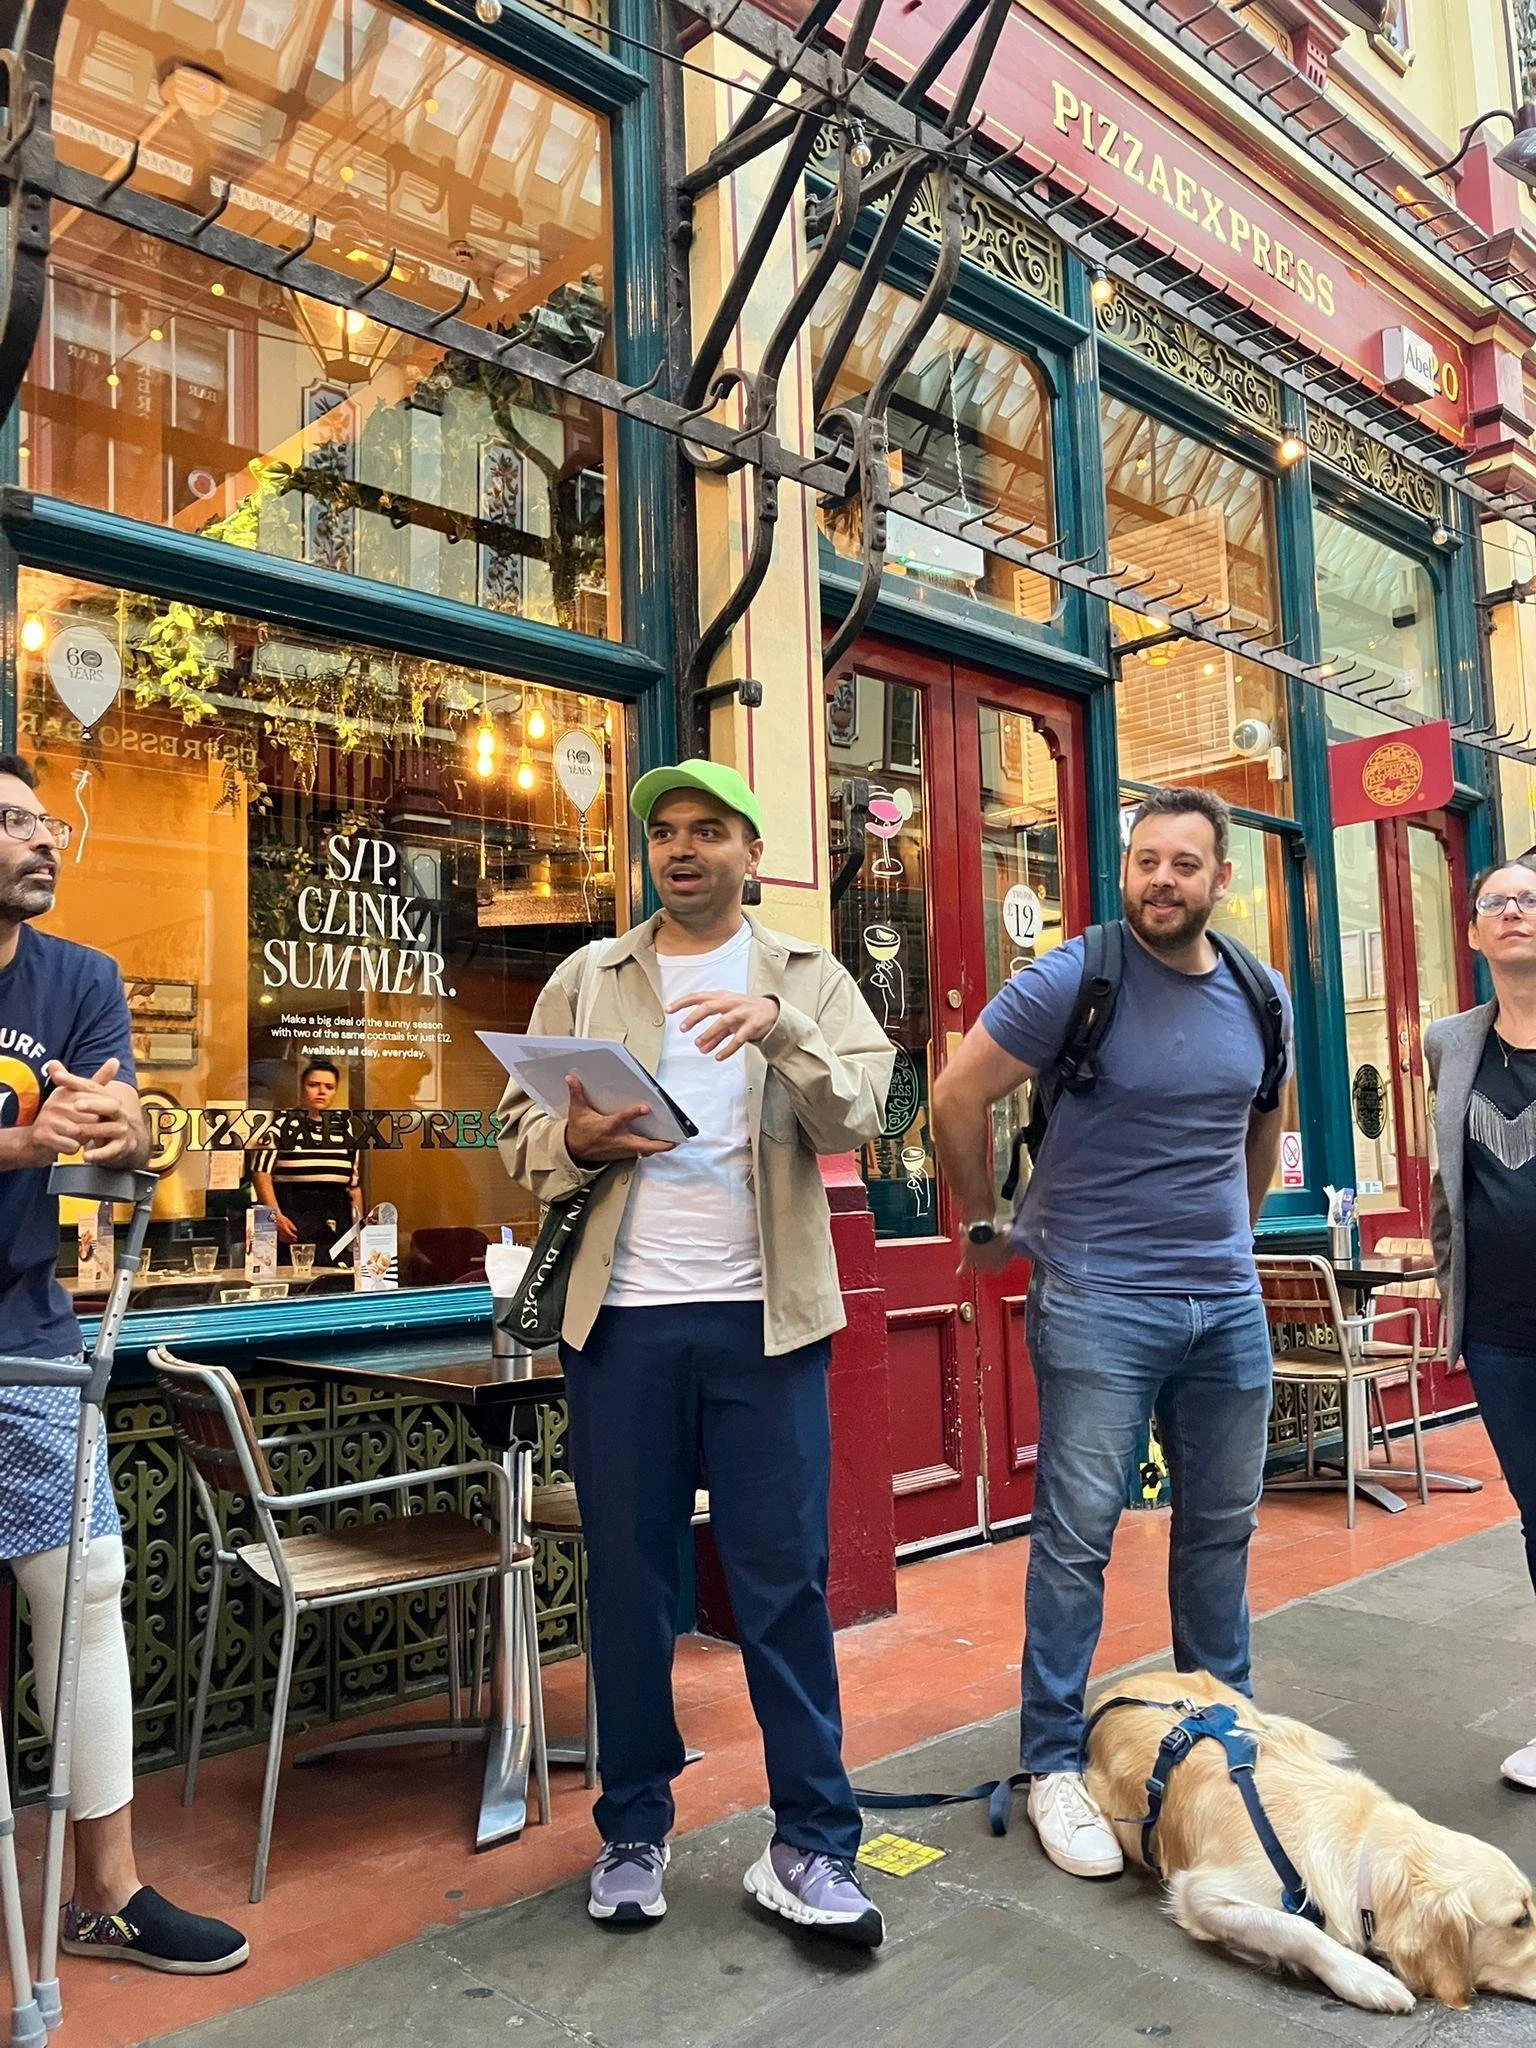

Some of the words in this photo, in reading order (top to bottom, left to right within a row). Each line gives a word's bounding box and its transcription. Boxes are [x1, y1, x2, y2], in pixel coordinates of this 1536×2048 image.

[1051, 79, 1335, 318] PIZZAEXPRESS
[1405, 343, 1432, 380] Abel
[66, 647, 103, 669] 60
[67, 665, 105, 682] YEARS
[566, 748, 591, 765] 60
[567, 763, 593, 777] YEARS
[328, 834, 397, 887] SIP.
[297, 885, 427, 943] CLINK.
[263, 938, 457, 998] SUMMER.
[281, 1013, 306, 1025] Make
[309, 1016, 315, 1025] a
[317, 1015, 332, 1028] big
[334, 1016, 354, 1027] deal
[355, 1017, 366, 1027] of
[367, 1018, 382, 1028] the
[384, 1020, 410, 1030] sunny
[412, 1021, 443, 1031] season
[271, 1027, 292, 1037] with
[293, 1029, 310, 1038] two
[312, 1028, 322, 1039] of
[324, 1029, 339, 1039] the
[341, 1031, 365, 1041] same
[367, 1031, 405, 1042] cocktails
[406, 1031, 418, 1042] for
[419, 1032, 436, 1044] just
[301, 1045, 345, 1056] Available
[347, 1045, 359, 1056] all
[360, 1045, 381, 1059] day,
[382, 1048, 426, 1060] everyday.
